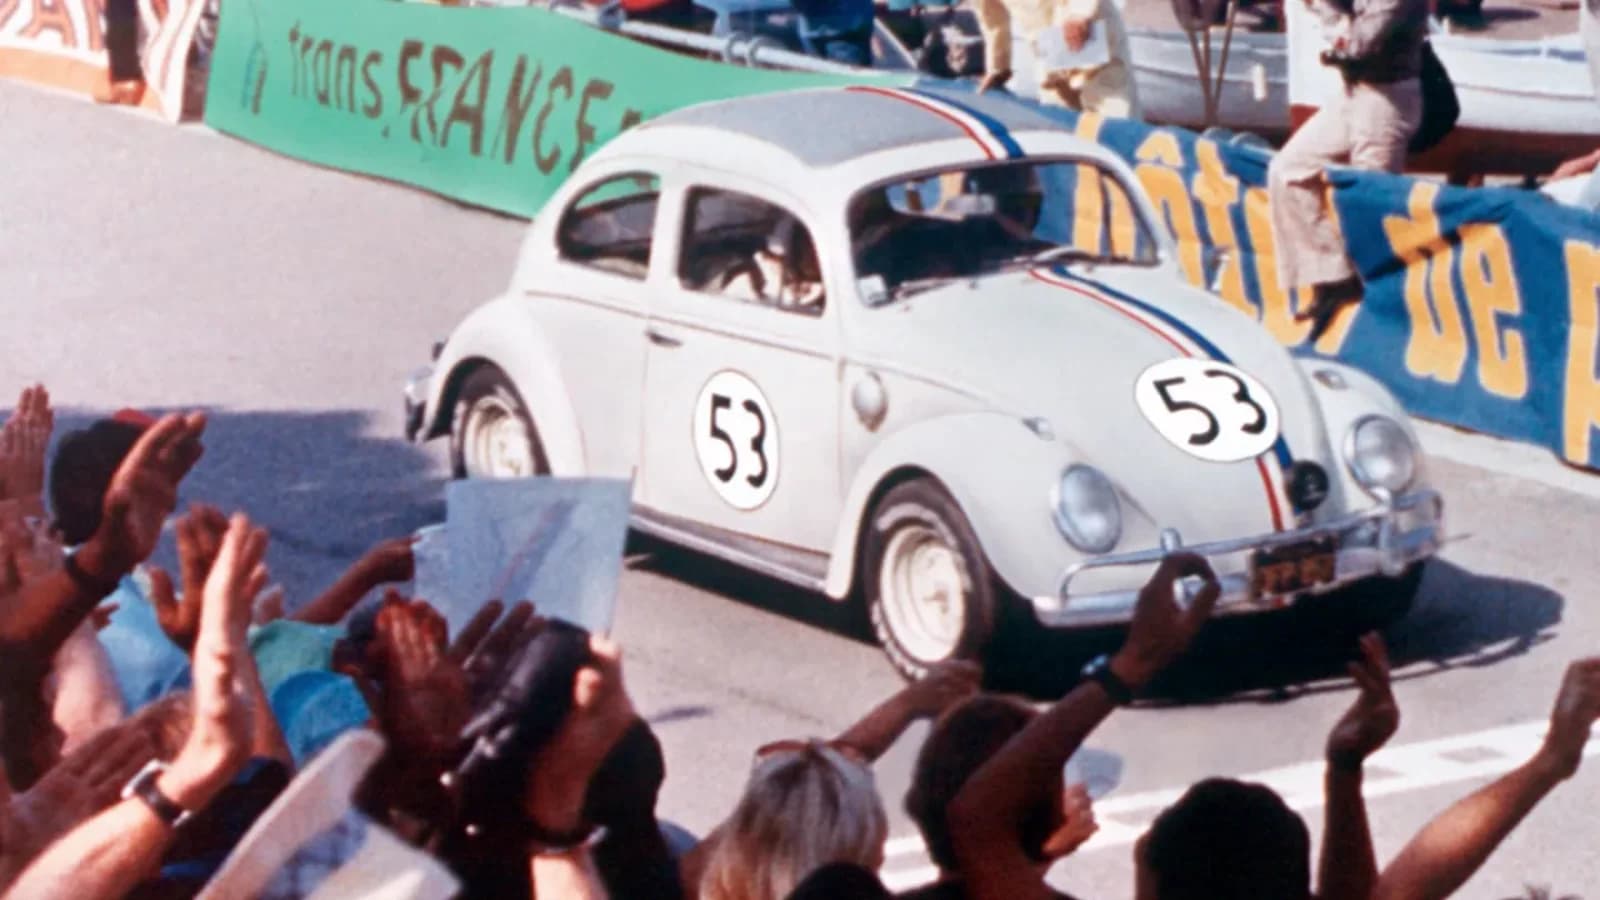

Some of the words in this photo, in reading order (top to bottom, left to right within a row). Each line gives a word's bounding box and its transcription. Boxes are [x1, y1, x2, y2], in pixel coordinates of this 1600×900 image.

[1383, 182, 1528, 399] de
[709, 392, 768, 488] 53
[1152, 368, 1267, 446] 53
